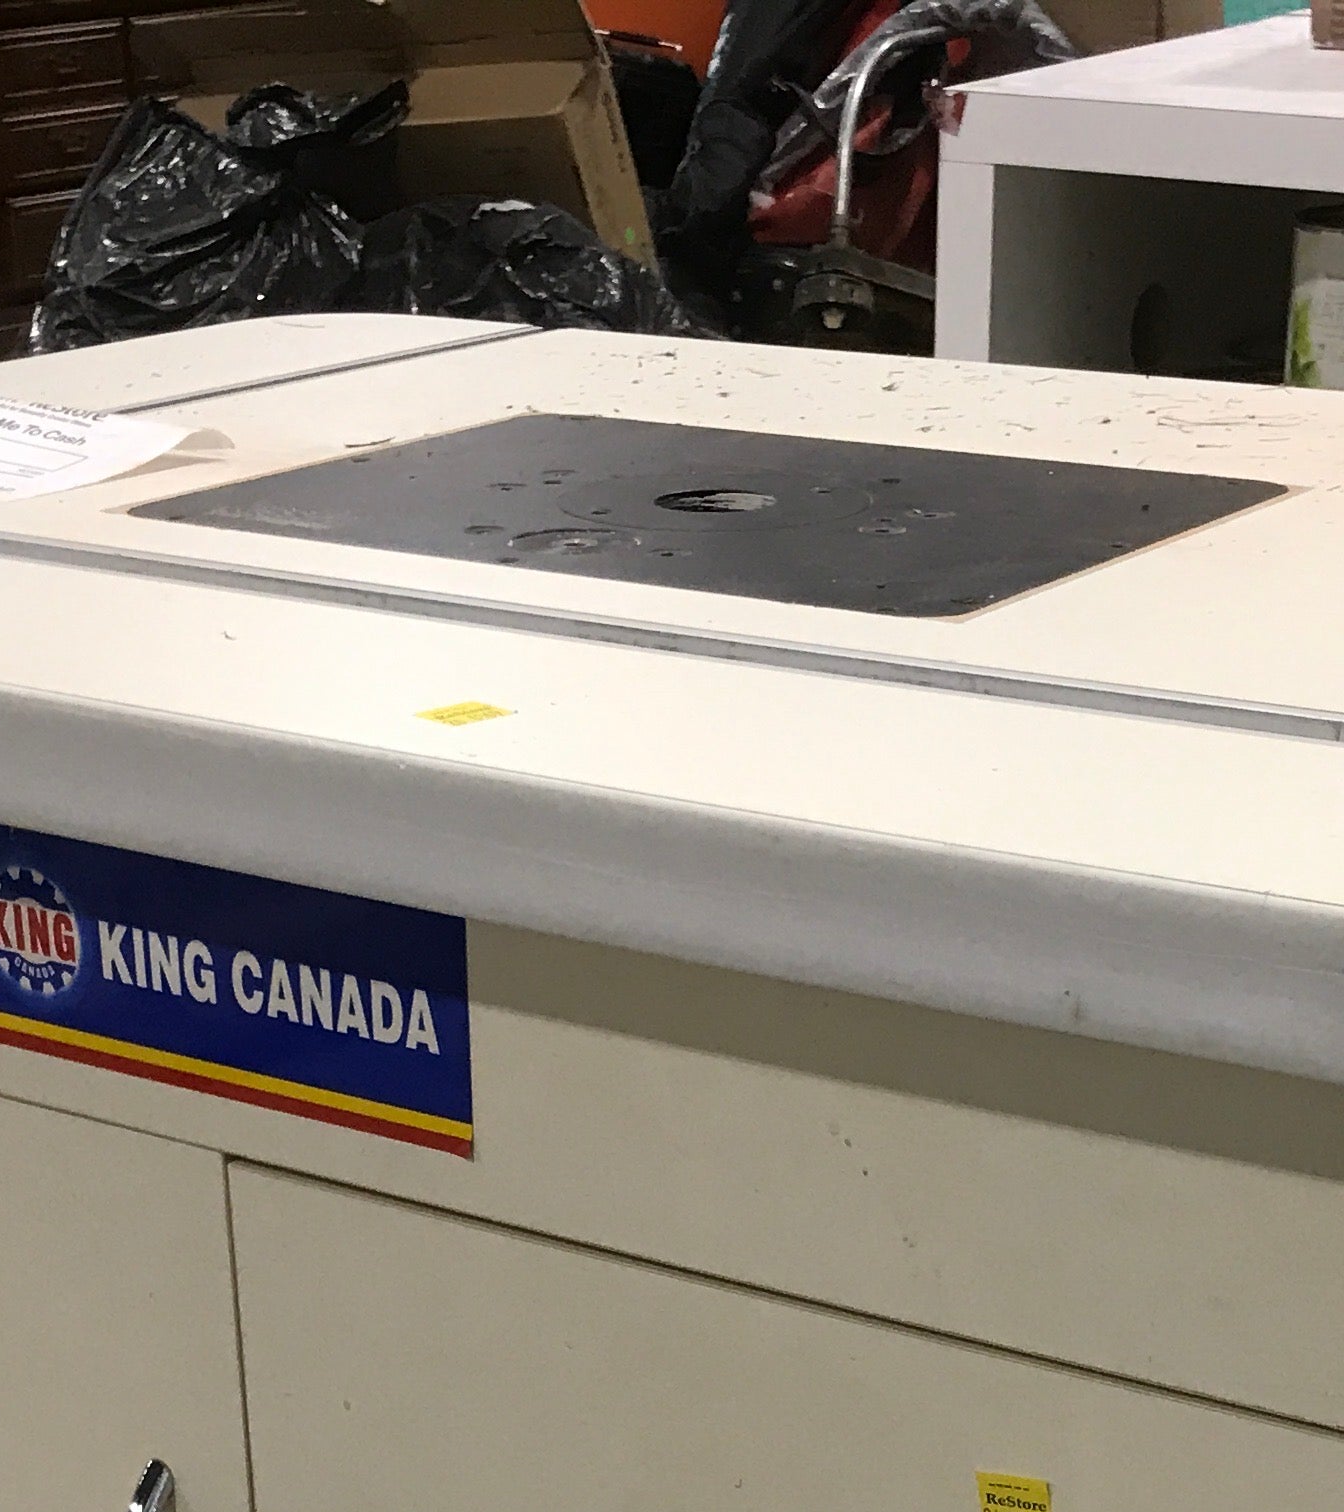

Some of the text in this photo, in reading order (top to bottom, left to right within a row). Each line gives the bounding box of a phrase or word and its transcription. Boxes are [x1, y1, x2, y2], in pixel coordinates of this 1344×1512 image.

[23, 424, 43, 436] To
[43, 430, 87, 446] Cash
[14, 956, 56, 979] CANADA
[97, 920, 442, 1056] KING CANADA
[985, 1492, 1047, 1512] ReStore
